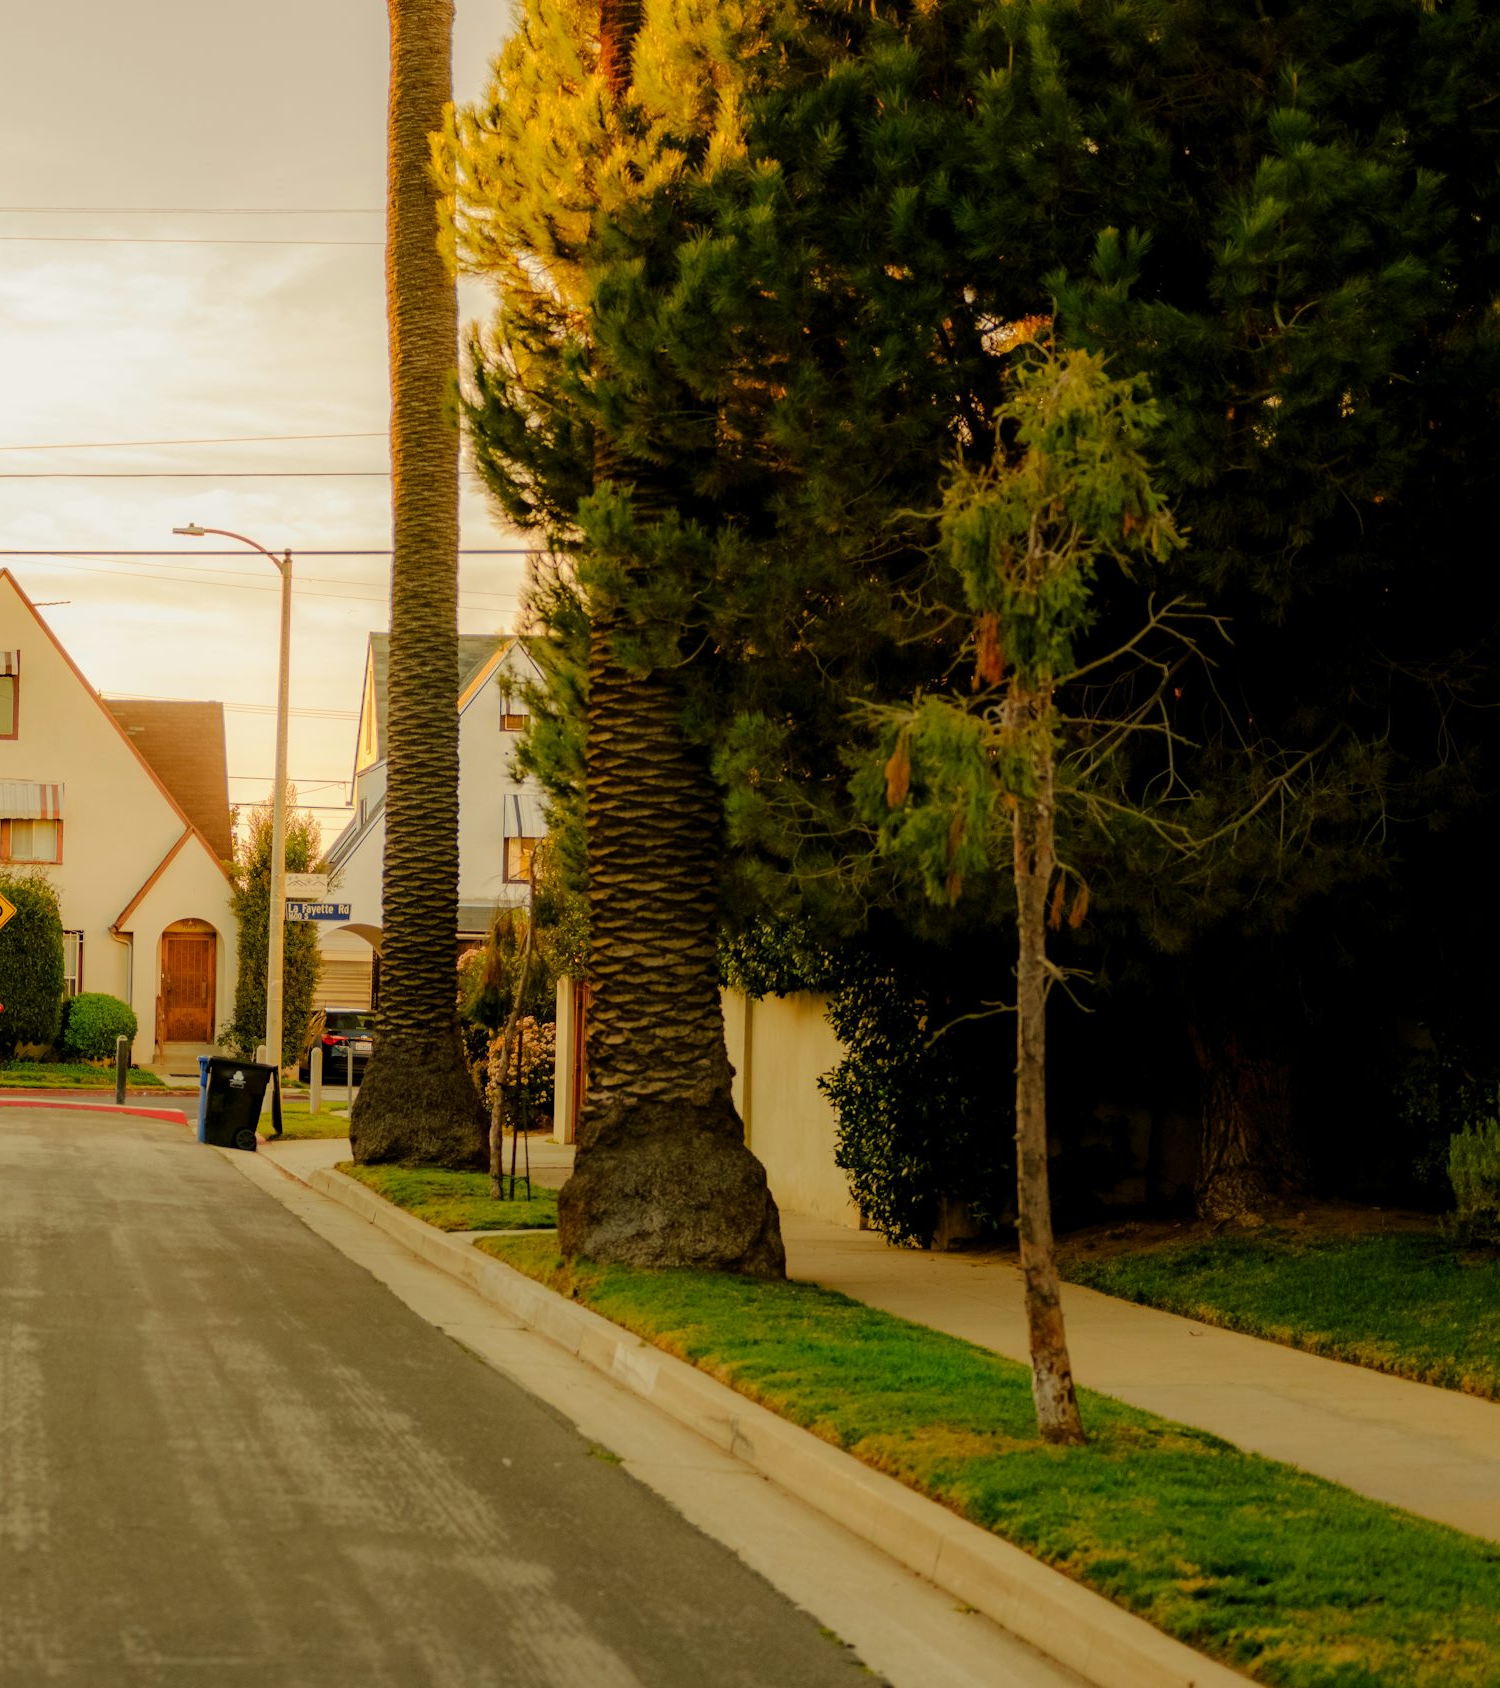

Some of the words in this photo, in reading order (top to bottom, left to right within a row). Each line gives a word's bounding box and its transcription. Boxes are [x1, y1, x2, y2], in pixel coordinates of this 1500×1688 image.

[288, 903, 298, 913] La
[302, 904, 334, 915] Fayette
[338, 905, 349, 914] Rd
